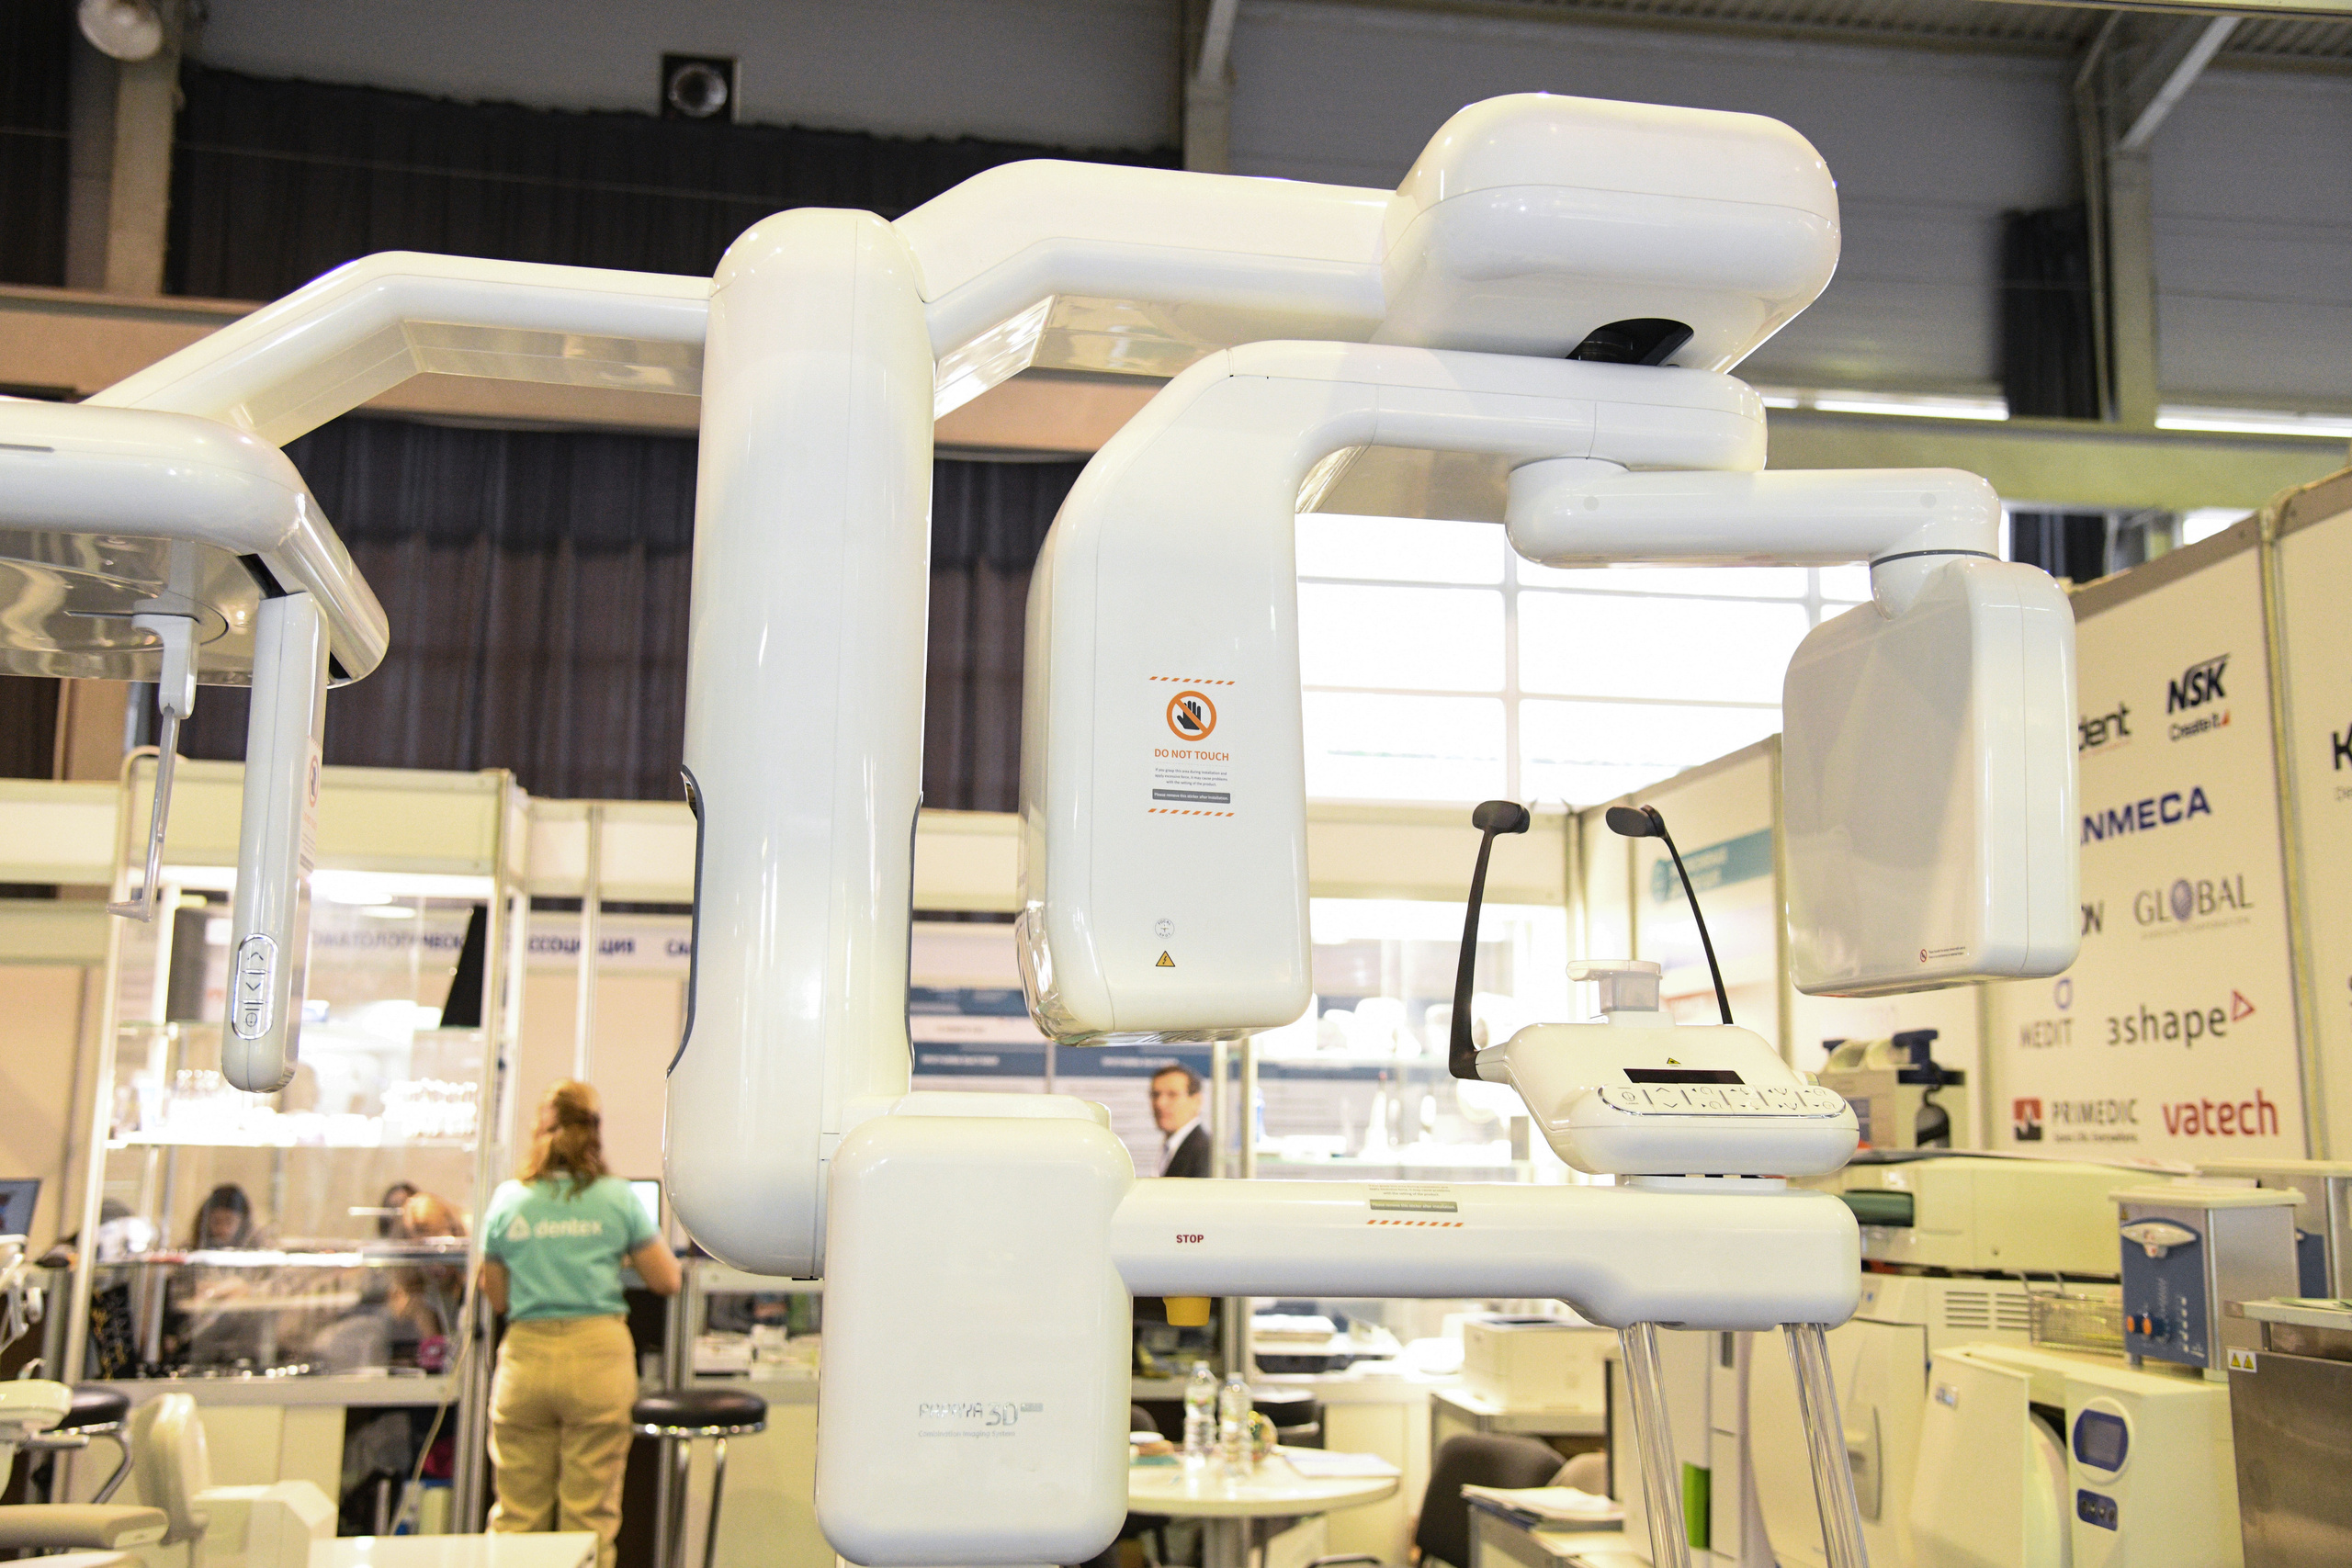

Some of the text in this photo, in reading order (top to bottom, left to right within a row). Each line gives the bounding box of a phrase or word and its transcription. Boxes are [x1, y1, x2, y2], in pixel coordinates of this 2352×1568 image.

[2167, 654, 2229, 715] NSK
[1154, 749, 1229, 761] DO NOT TOUCH
[2080, 786, 2212, 846] NMECA
[2133, 874, 2255, 927] GLOBAL
[2107, 1002, 2227, 1049] 3shape
[2161, 1087, 2278, 1136] vatech
[1176, 1234, 1204, 1244] STOP
[918, 1429, 1016, 1439] Combination Imaging System
[919, 1402, 983, 1418] PAPAYA
[985, 1401, 1019, 1427] 3D
